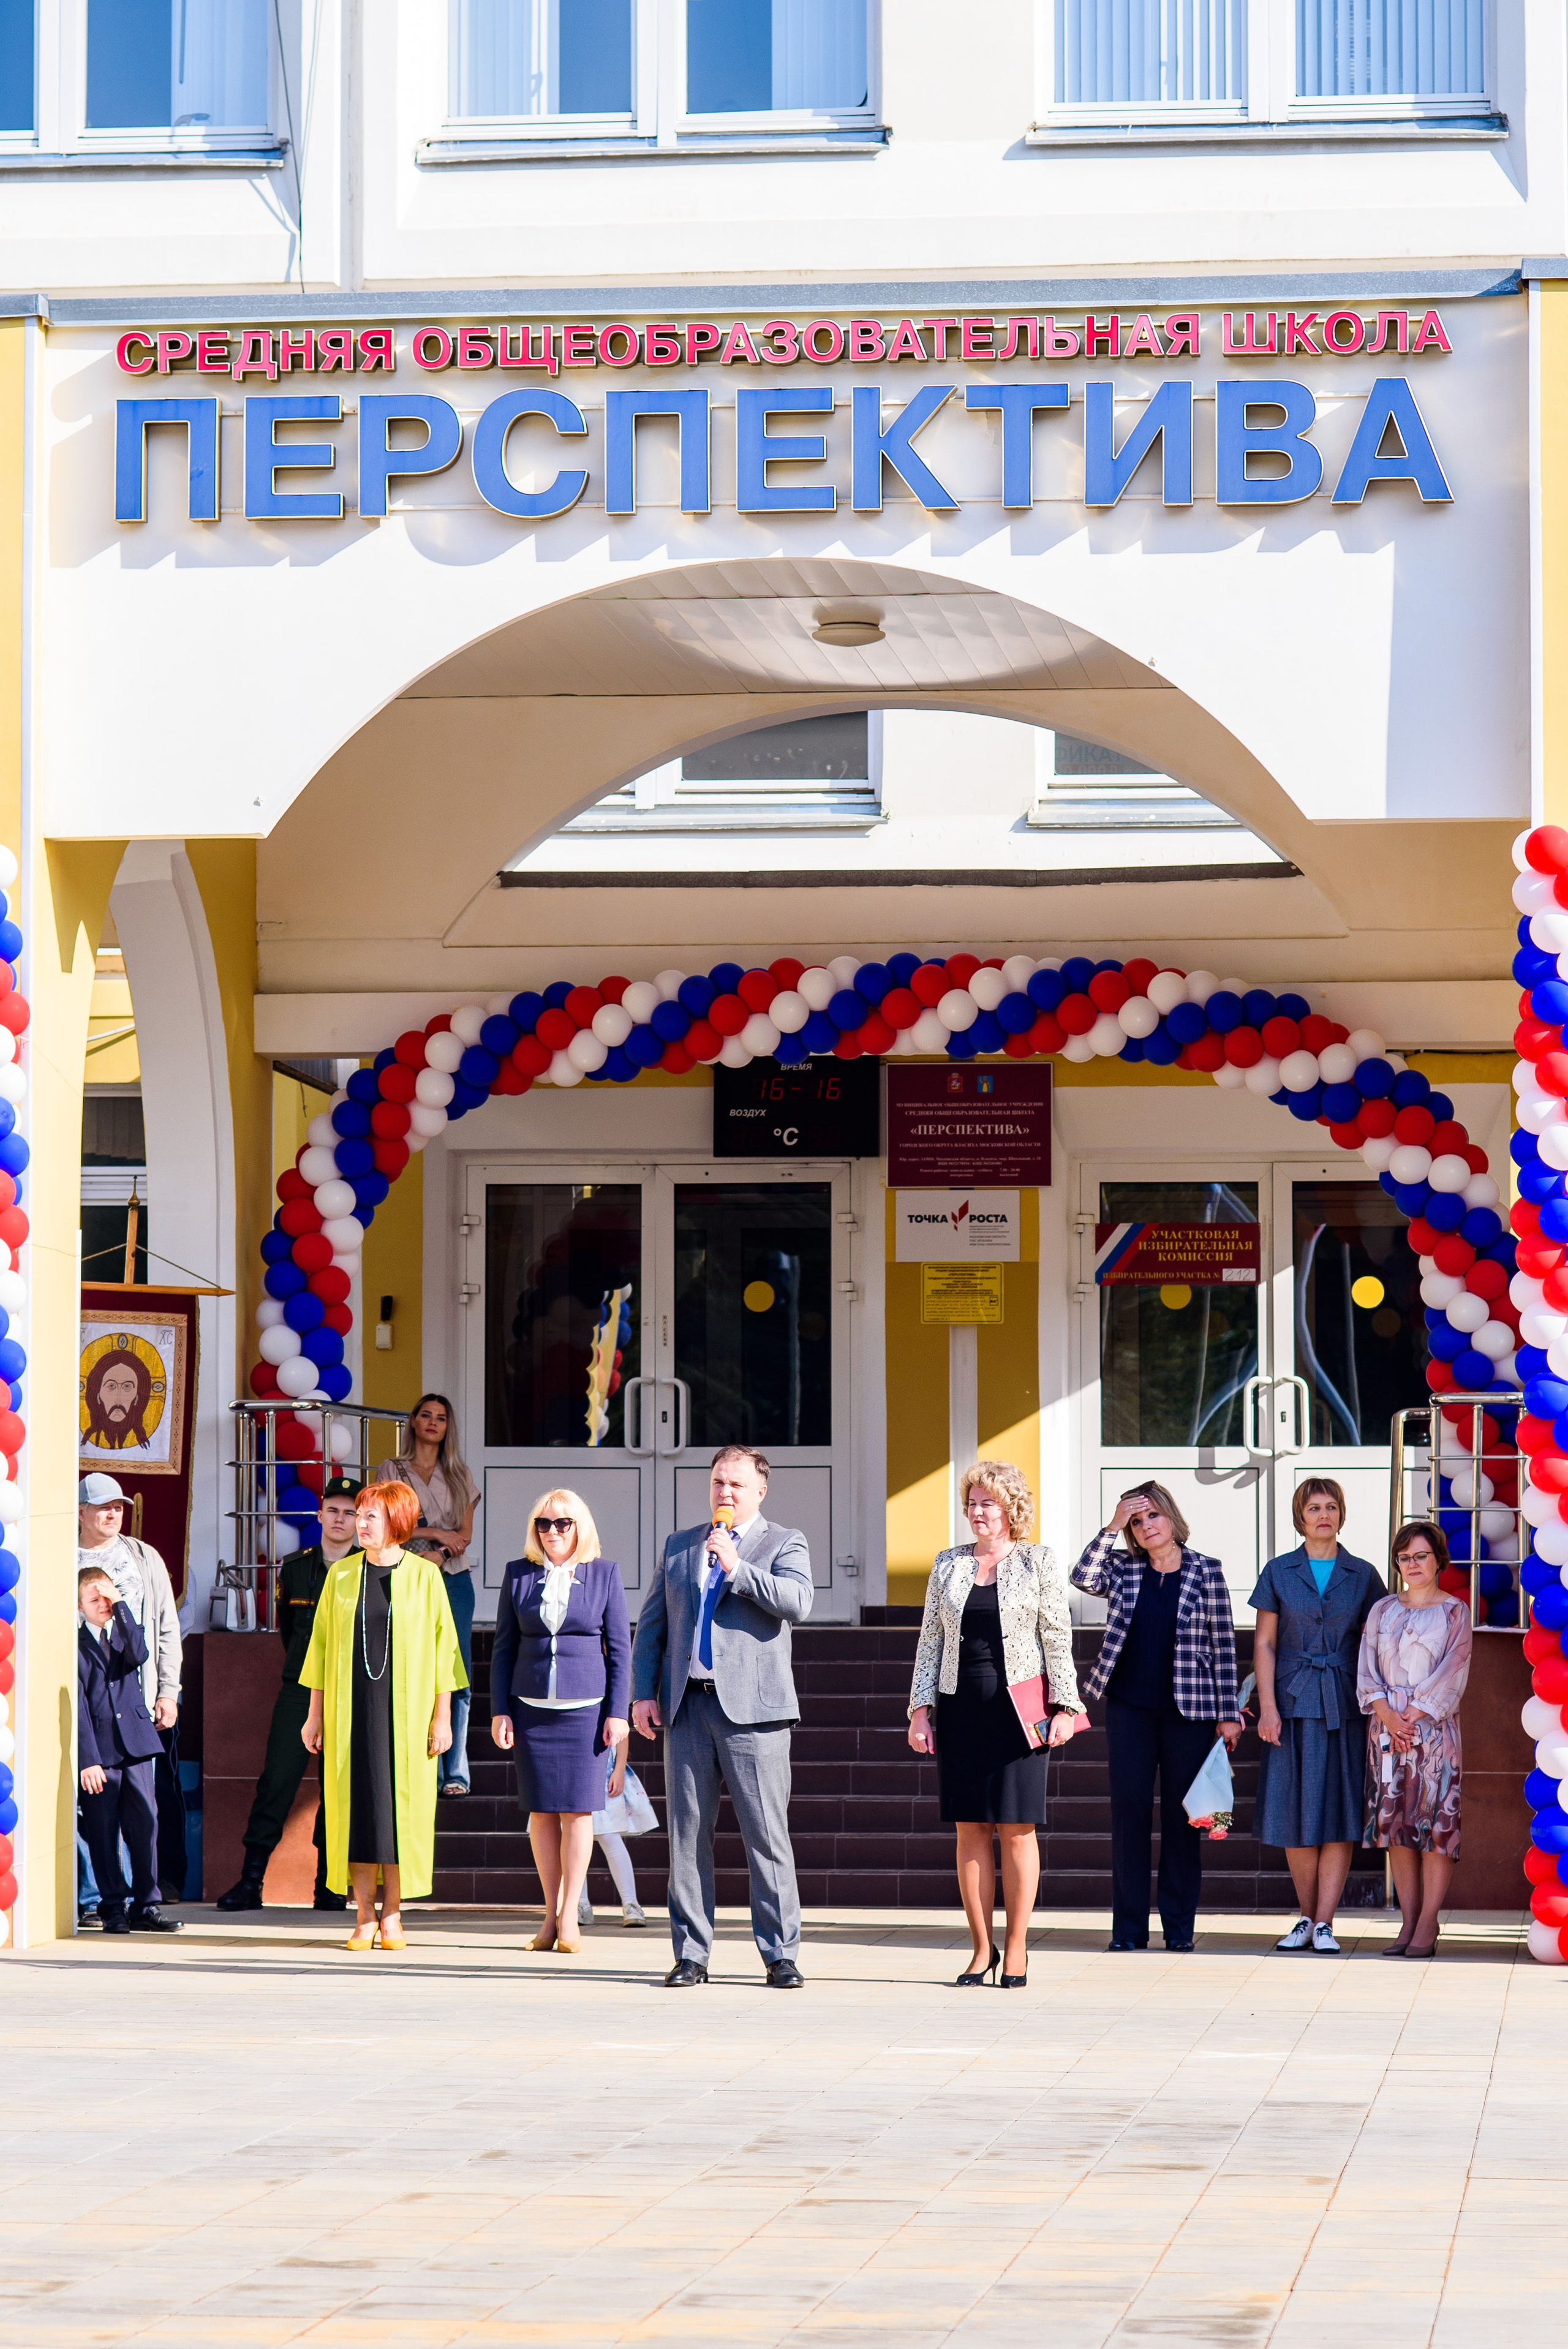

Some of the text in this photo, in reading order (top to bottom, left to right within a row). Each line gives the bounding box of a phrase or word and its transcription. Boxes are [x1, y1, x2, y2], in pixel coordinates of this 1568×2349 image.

[116, 309, 1453, 382] СРЕДНЯЯ ОБЩЕОБРАЗОВАТЕЛЬНАЯ ШКОЛА
[115, 376, 1454, 523] ПЕРСПЕКТИВА
[729, 1109, 766, 1118] ВОЗДУХ
[910, 1124, 1030, 1135] «ПЕРСПЕКТИВА»
[908, 1214, 1008, 1223] ТОЧКА РОСТА
[1152, 1230, 1239, 1239] УЧАСТКОВАЯ
[1138, 1241, 1253, 1251] ИЗБИРАТЕЛЬНАЯ
[1158, 1252, 1233, 1262] КОМИССИЯ
[1225, 1269, 1251, 1281] 212
